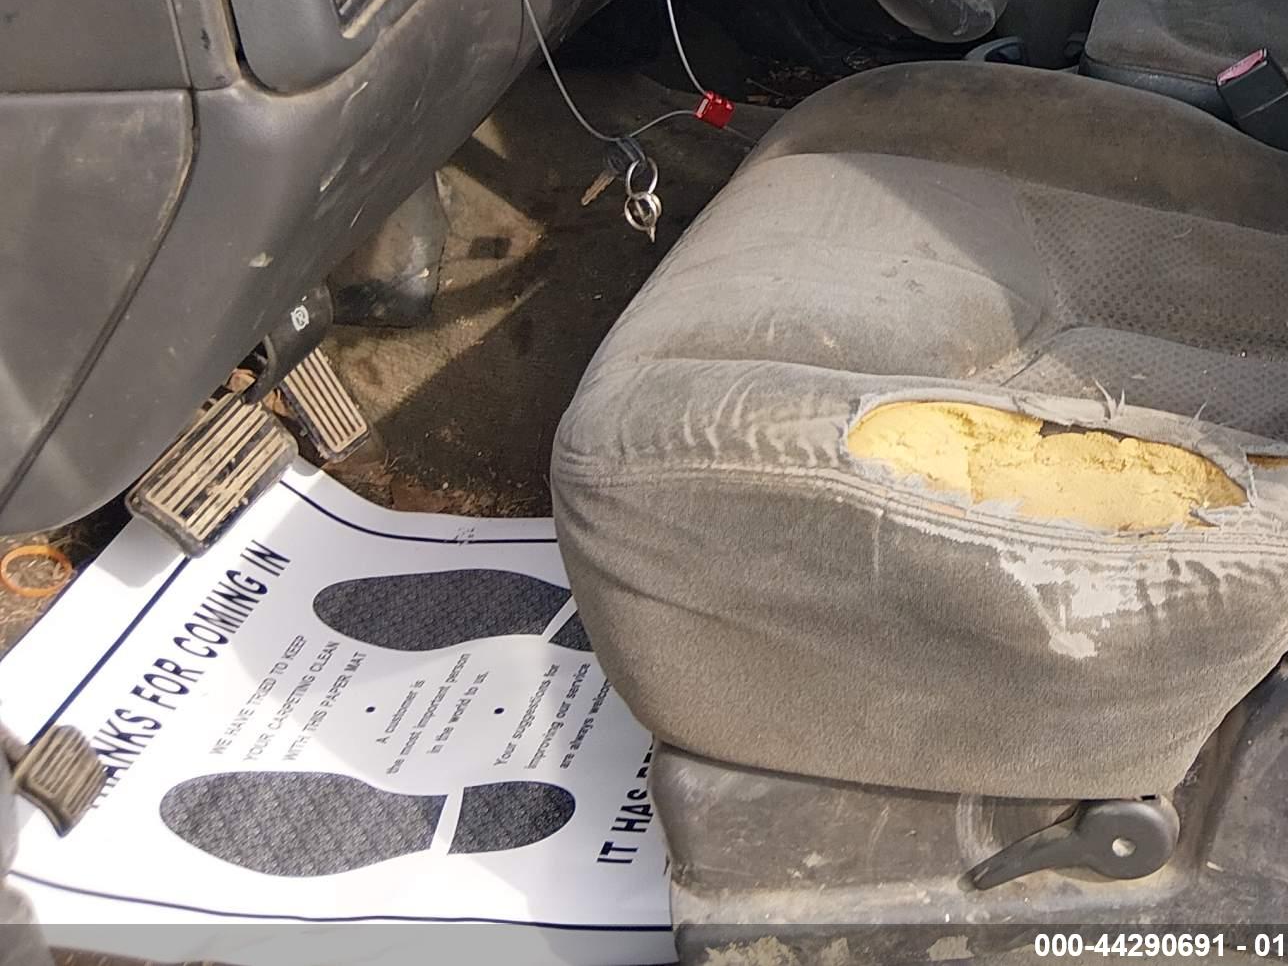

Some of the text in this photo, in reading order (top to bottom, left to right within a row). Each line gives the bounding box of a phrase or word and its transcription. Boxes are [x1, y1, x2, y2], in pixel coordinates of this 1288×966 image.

[92, 539, 291, 809] ANKS FOR COMING IN
[209, 737, 232, 754] WE
[224, 707, 255, 736] HAVE
[246, 677, 277, 705] TRIED
[269, 661, 289, 675] TO
[243, 640, 341, 761] YOUR CARPETING CLEAN
[302, 709, 328, 732] THIS
[320, 674, 352, 708] PAPER
[344, 651, 367, 673] MAT
[556, 701, 571, 719] our
[566, 663, 591, 699] service
[376, 679, 426, 744] A customer is
[386, 653, 472, 775] the most important person
[435, 726, 455, 742] the
[448, 698, 472, 724] world
[464, 686, 479, 696] to
[493, 664, 561, 766] Your suggestions for
[560, 753, 575, 769] are
[569, 717, 594, 750] always
[610, 789, 654, 833] HAS
[597, 841, 639, 864] IT
